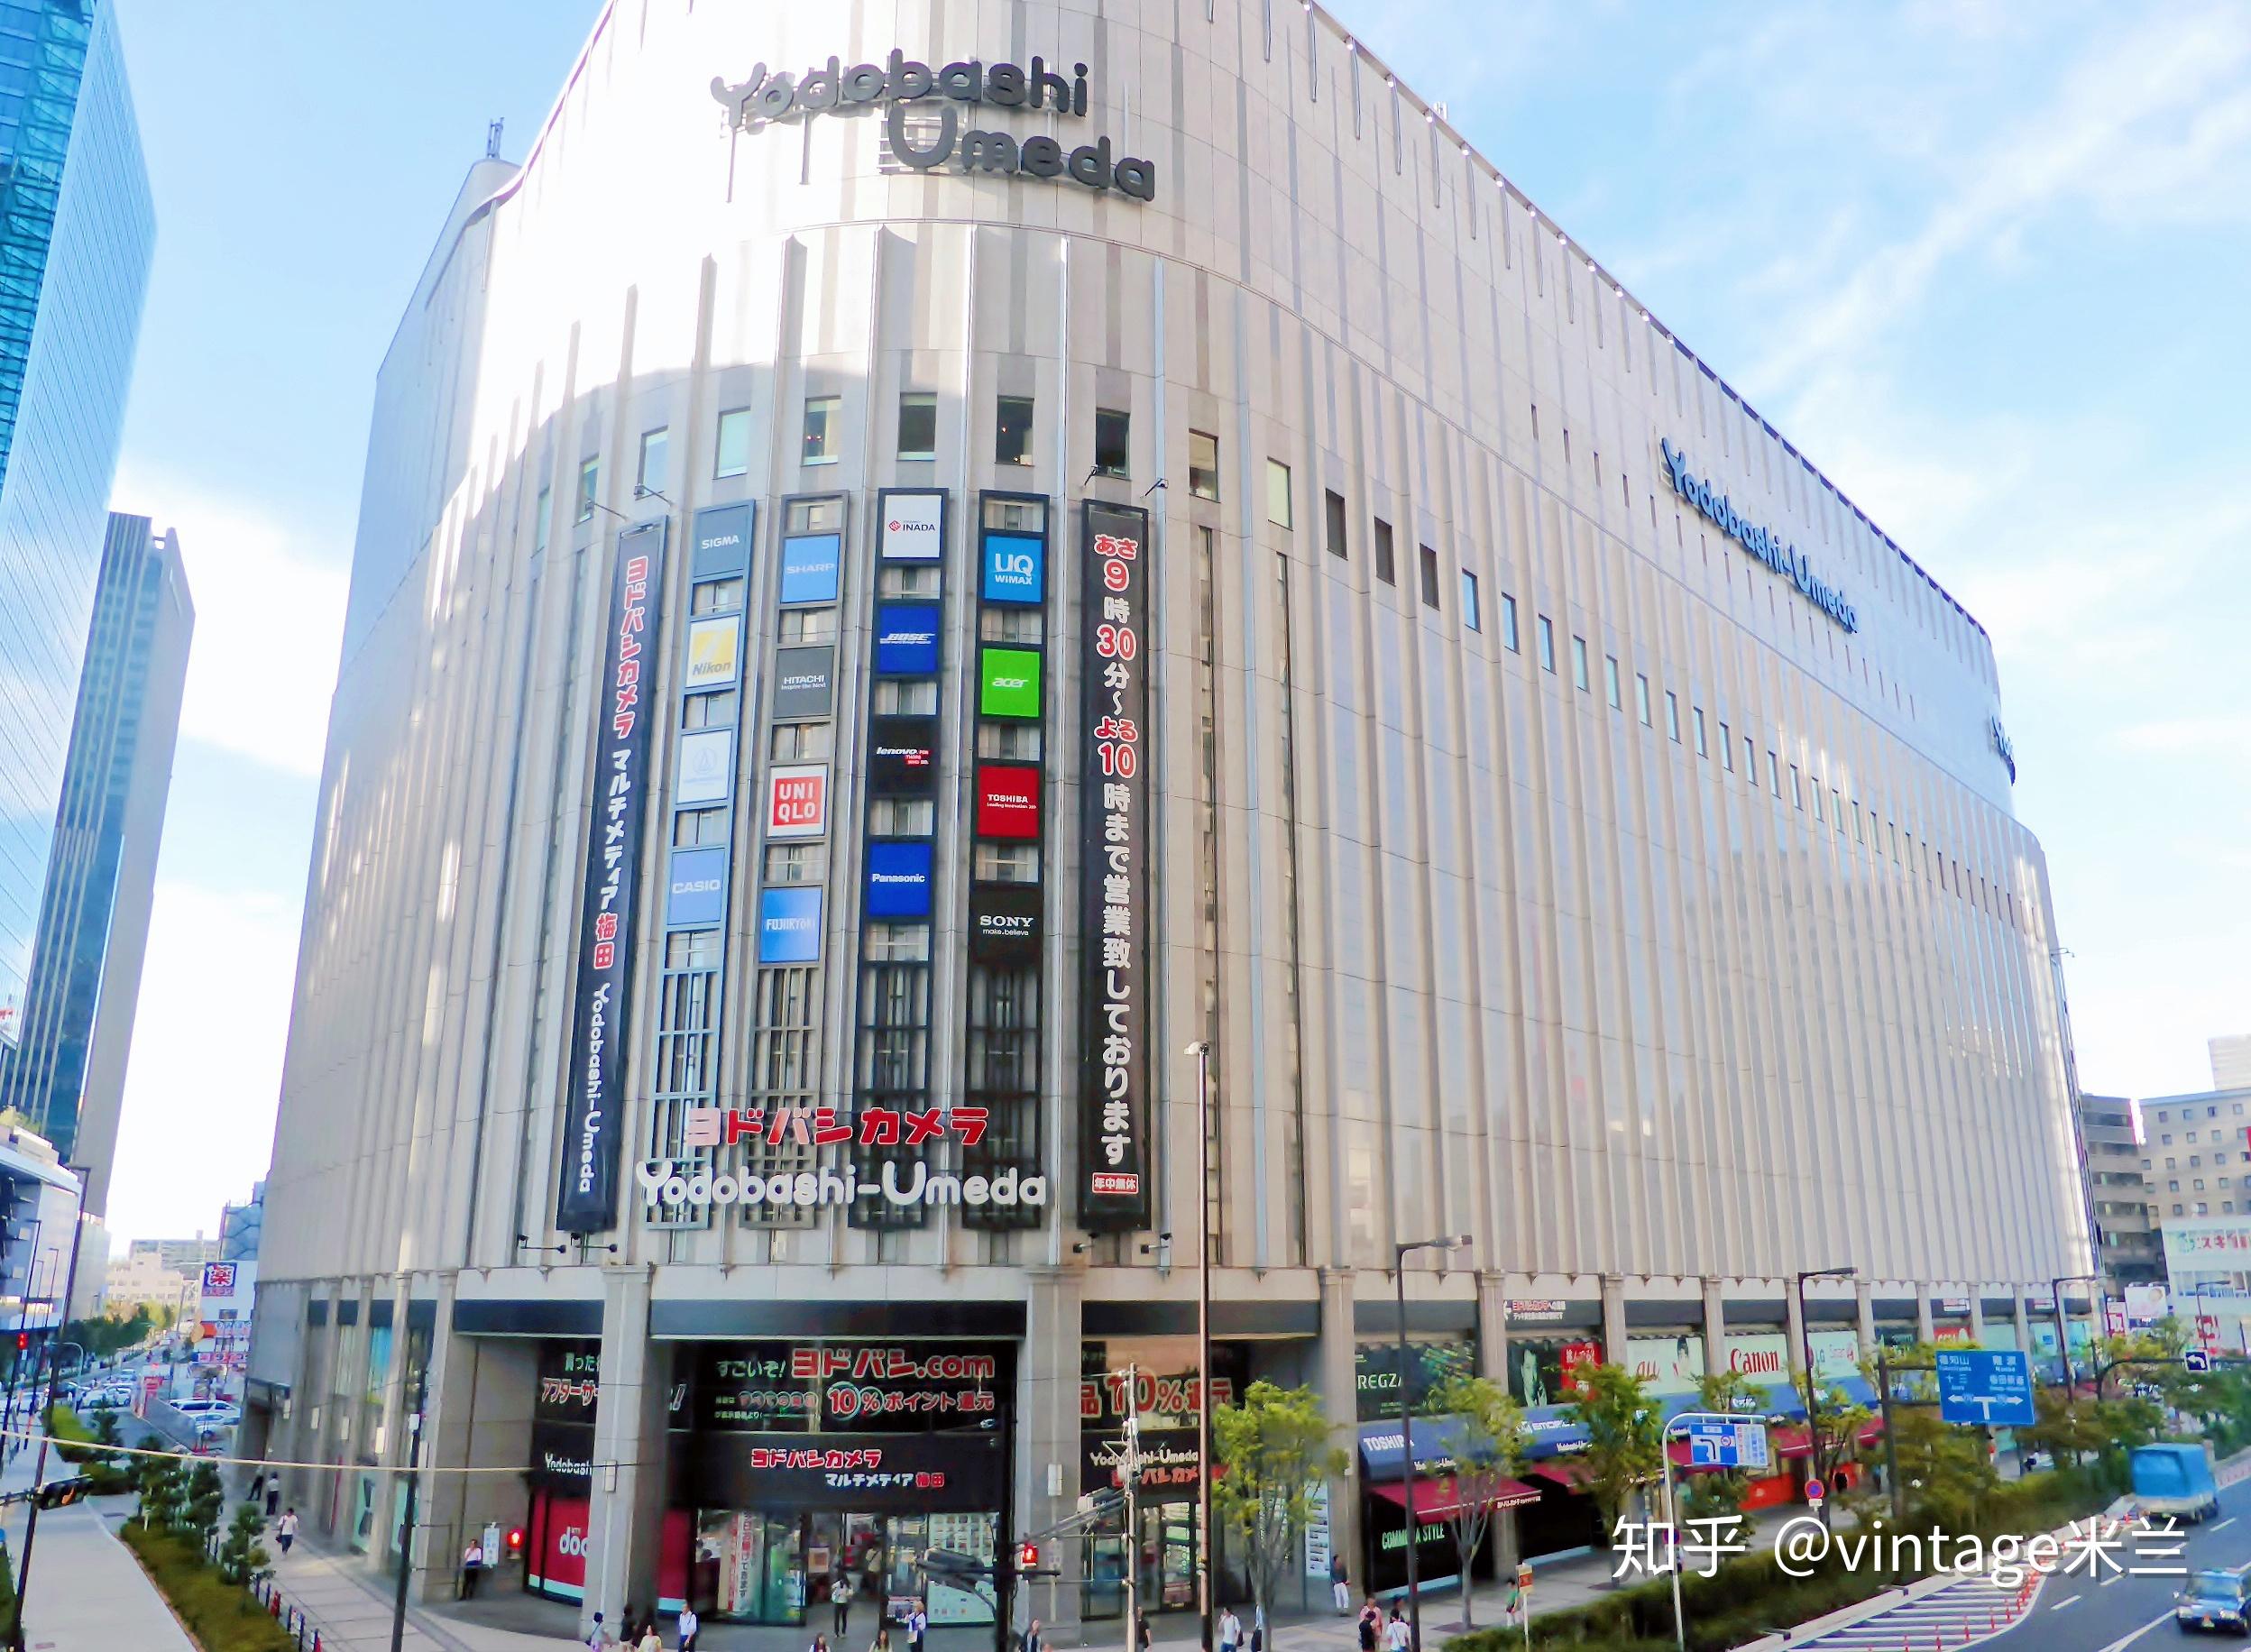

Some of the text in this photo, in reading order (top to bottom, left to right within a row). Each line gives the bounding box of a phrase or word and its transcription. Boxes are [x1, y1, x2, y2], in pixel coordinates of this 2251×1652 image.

[711, 48, 1088, 128] Yodobashi
[887, 106, 1155, 201] Umeda
[701, 534, 740, 549] SIGMA
[786, 563, 835, 574] SHARP
[995, 554, 1034, 575] UQ
[995, 574, 1033, 585] WIMAX
[692, 661, 731, 676] Nikon
[784, 675, 824, 684] HITACHI
[992, 678, 1028, 688] acer
[877, 747, 918, 755] lenovo
[778, 783, 813, 800] UNI
[988, 794, 1028, 803] TOSHIBA
[777, 802, 816, 822] QLO
[579, 555, 648, 1192] ヨドバシカメラ マルチメディア梅田 Yodobashi-Umeda
[872, 873, 925, 883] Panasonic
[672, 879, 721, 894] CASIO
[979, 915, 1034, 927] SONY
[687, 1107, 989, 1146] ヨドバシカメラ
[636, 1161, 1046, 1206] Yodobashi-Umeda
[208, 1265, 233, 1286] 薬
[792, 1348, 995, 1379] ヨドバシ.com
[1731, 1348, 1779, 1376] Canon
[750, 1448, 882, 1469] ヨドバシカメラ
